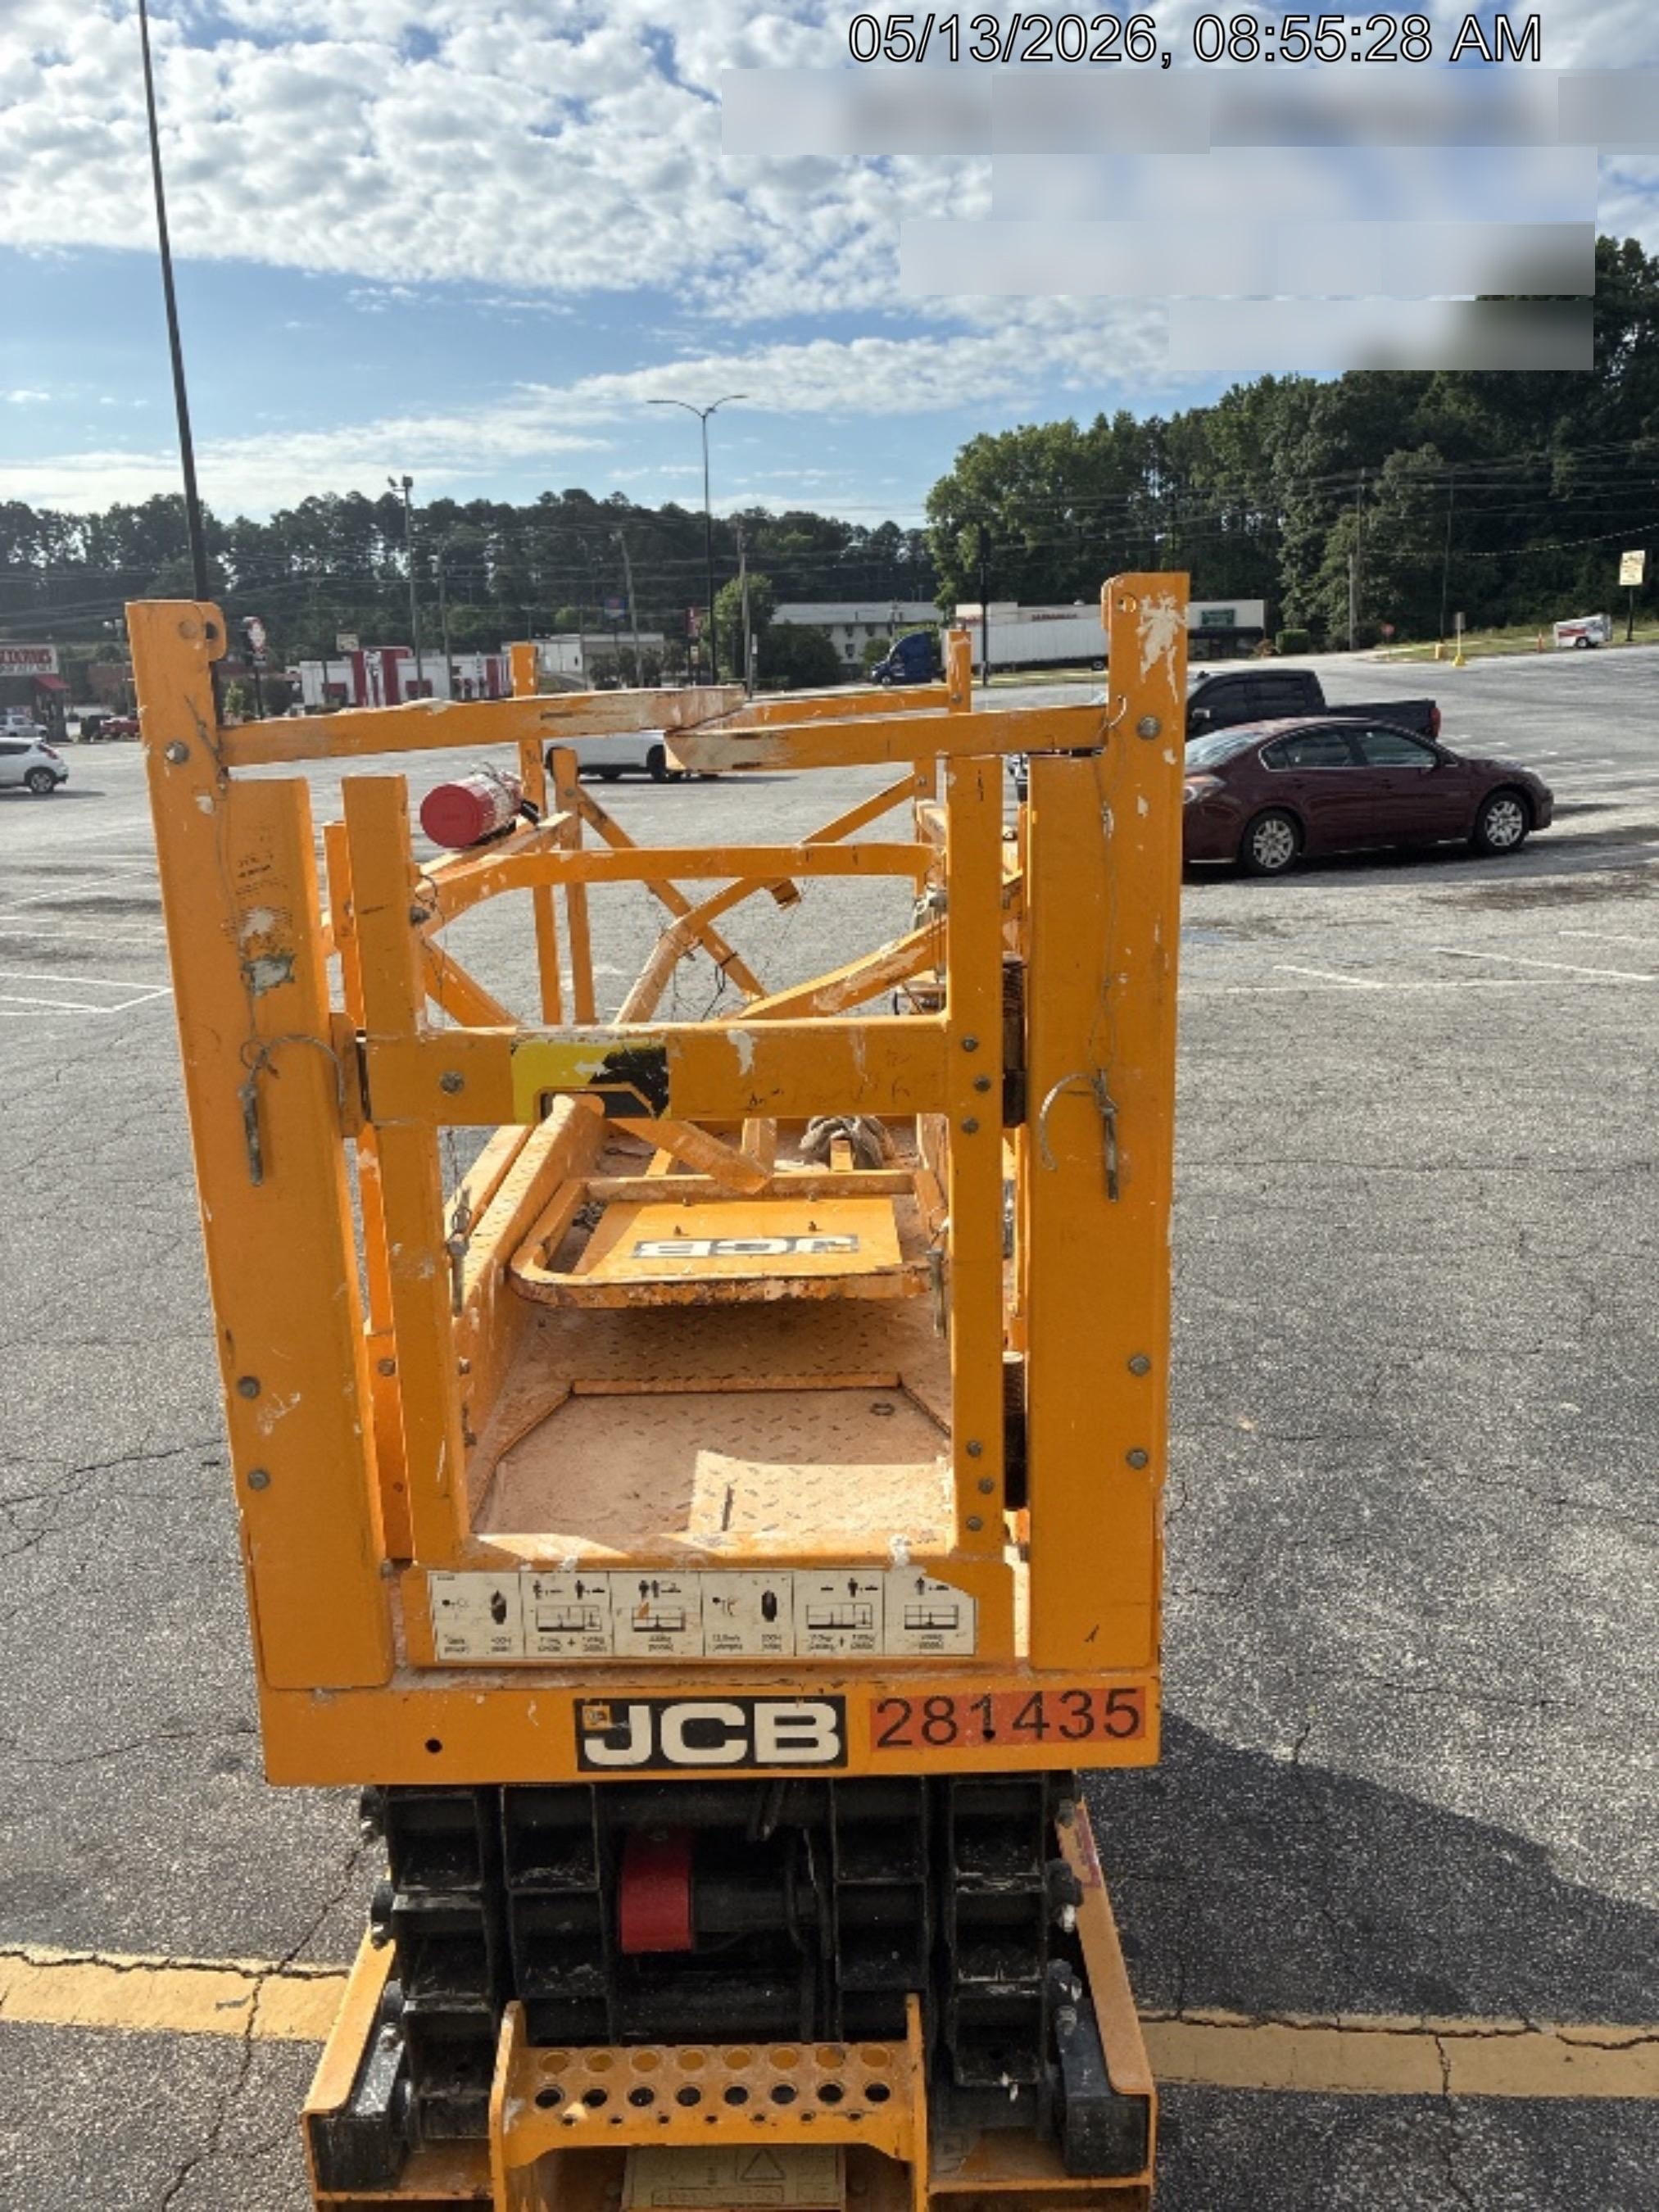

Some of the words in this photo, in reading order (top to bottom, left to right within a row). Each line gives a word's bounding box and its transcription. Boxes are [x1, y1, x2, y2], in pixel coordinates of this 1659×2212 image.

[636, 1235, 853, 1258] JCB
[583, 1702, 841, 1766] JCB
[876, 1688, 1141, 1747] 281435
